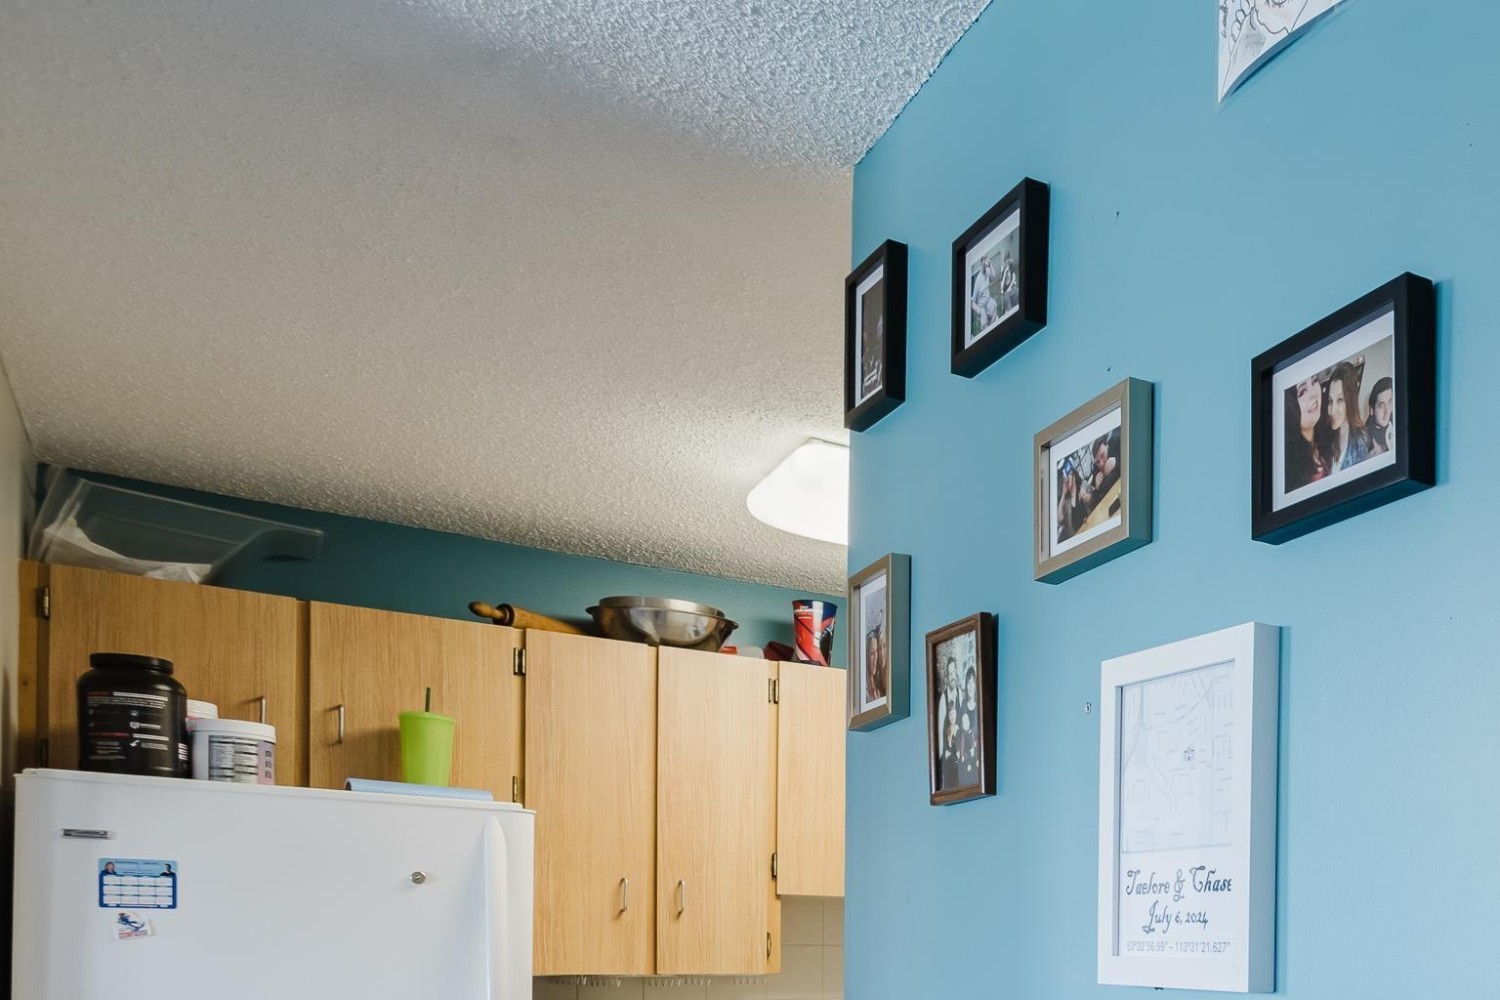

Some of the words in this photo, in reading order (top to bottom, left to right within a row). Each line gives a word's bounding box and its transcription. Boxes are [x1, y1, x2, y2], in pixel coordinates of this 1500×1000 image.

[1173, 868, 1185, 902] &
[1142, 900, 1173, 934] July
[1185, 911, 1209, 929] 2024
